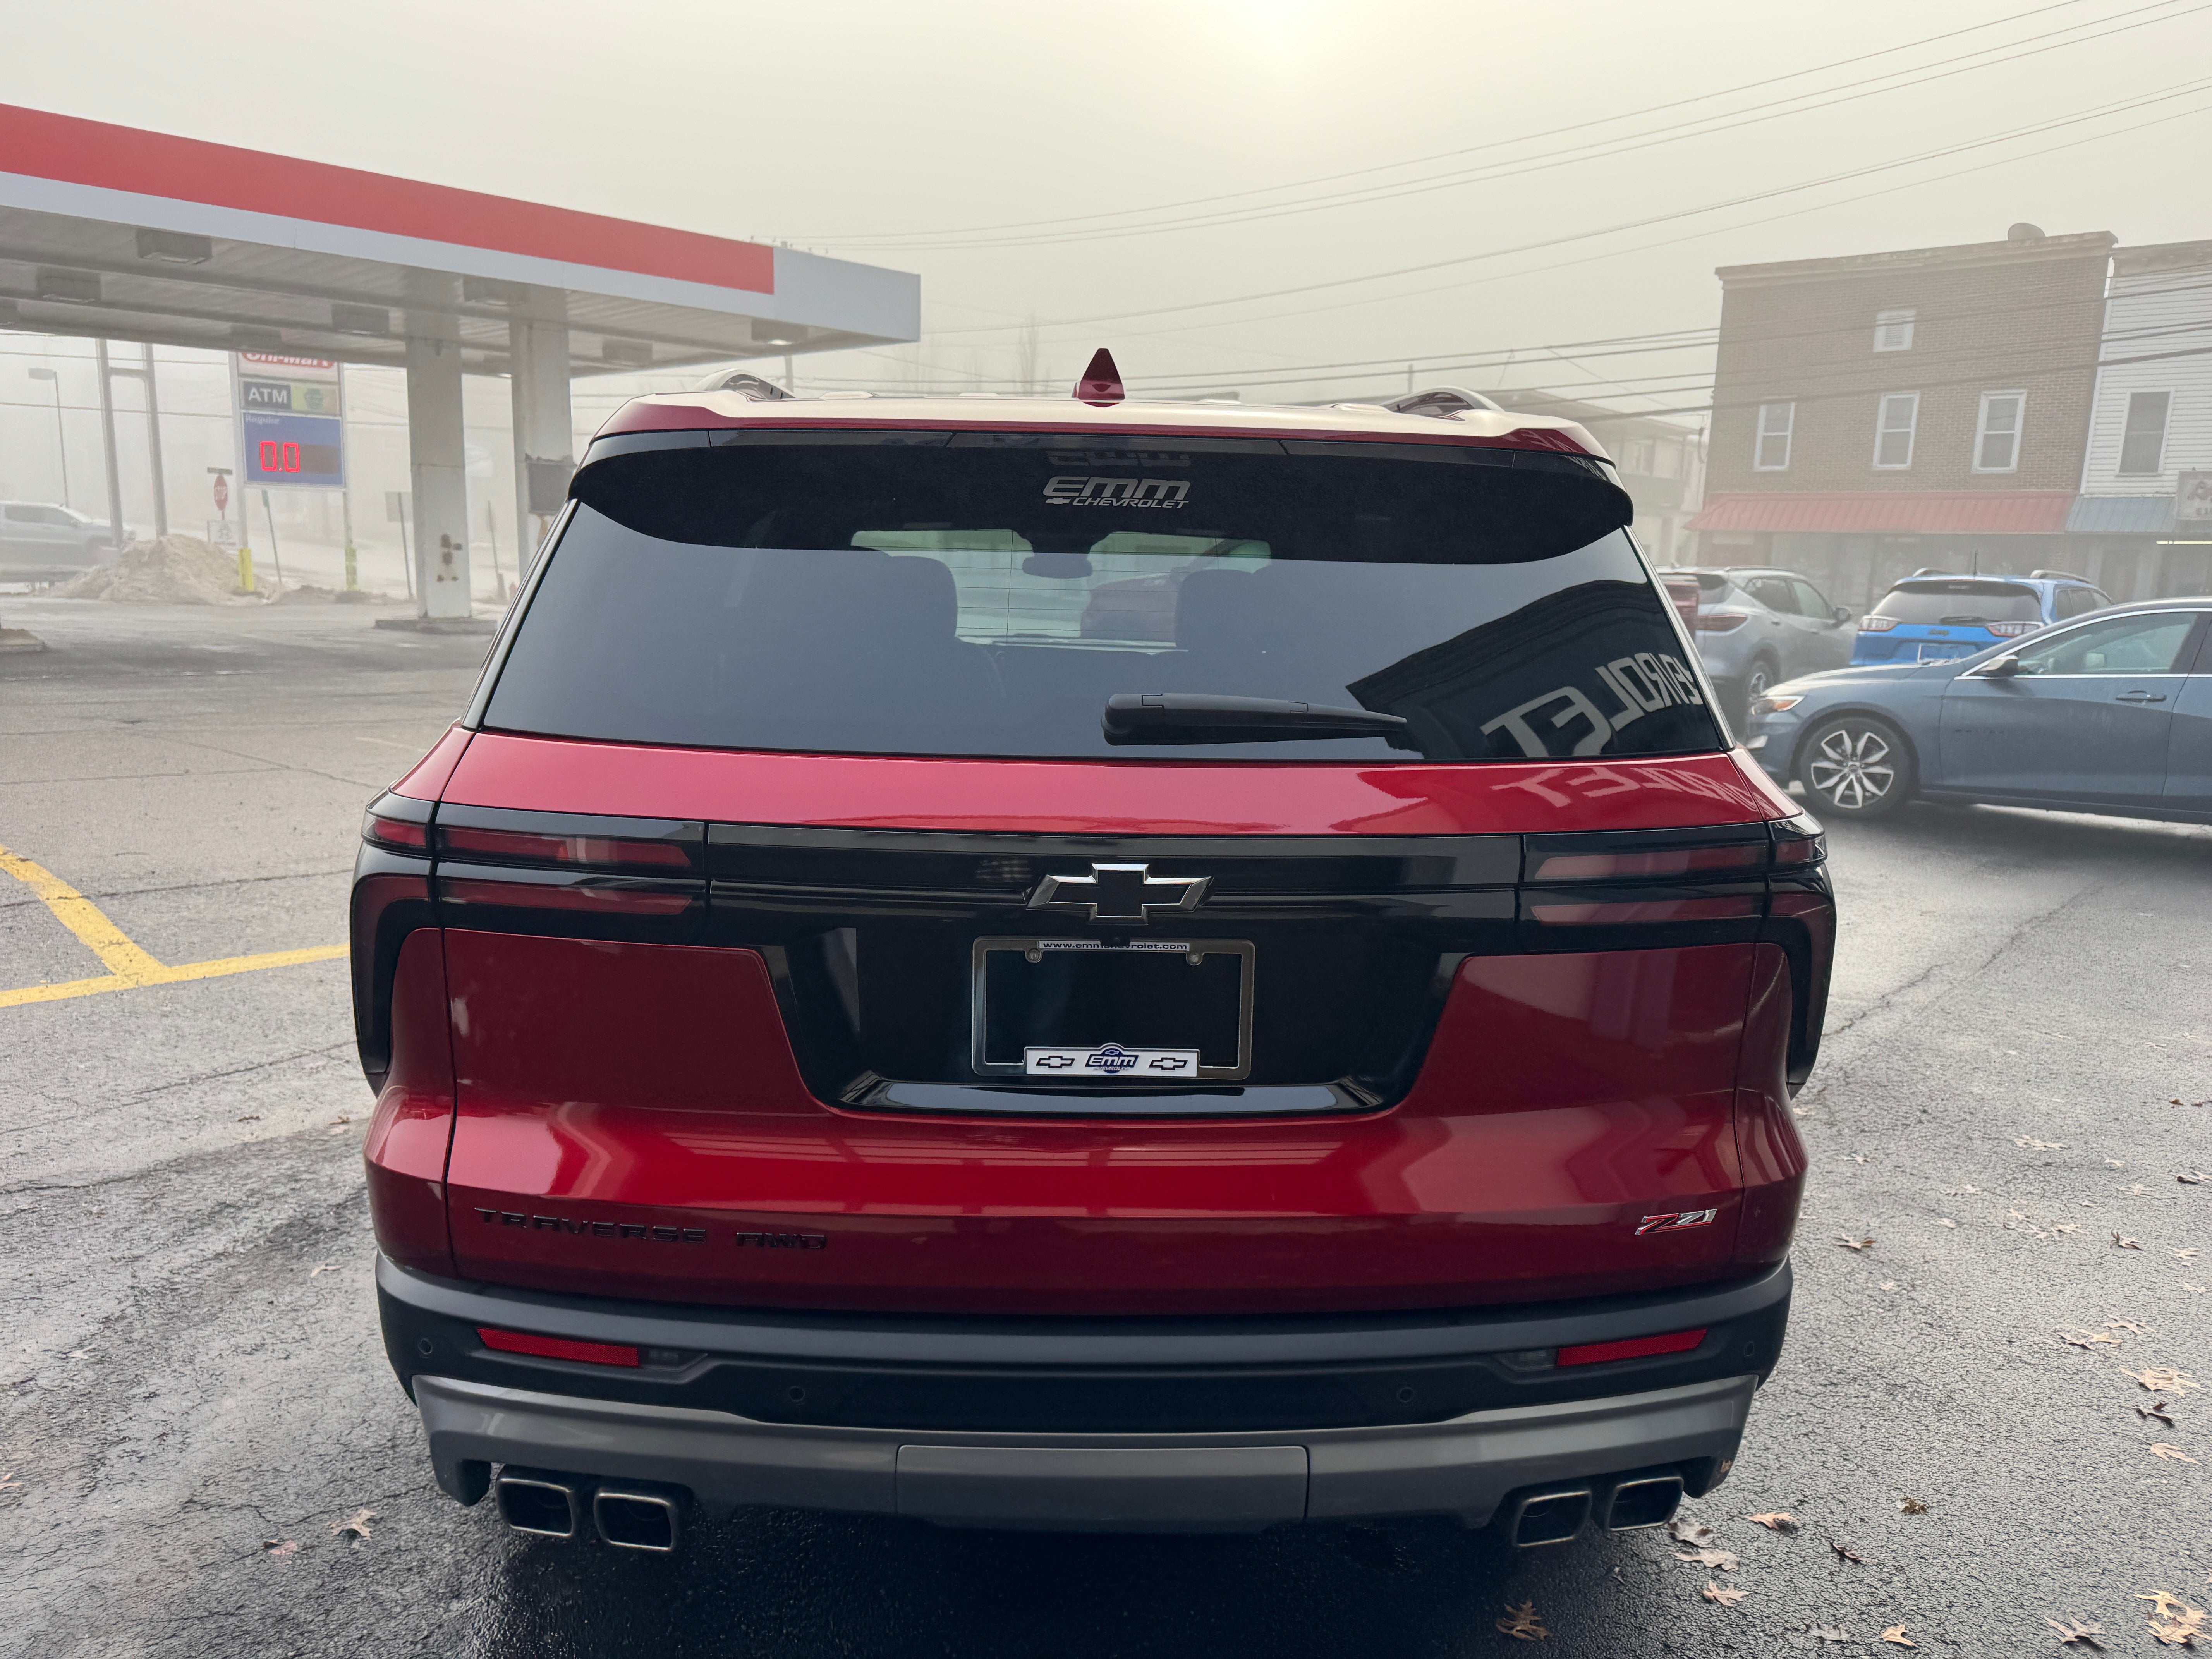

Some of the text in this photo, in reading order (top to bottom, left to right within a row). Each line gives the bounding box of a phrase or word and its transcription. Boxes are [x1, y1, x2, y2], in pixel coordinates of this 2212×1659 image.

[248, 387, 287, 404] ATM
[260, 441, 300, 472] 0.0
[1072, 497, 1189, 508] CHEVROLET
[474, 1207, 706, 1243] TRAVERSE
